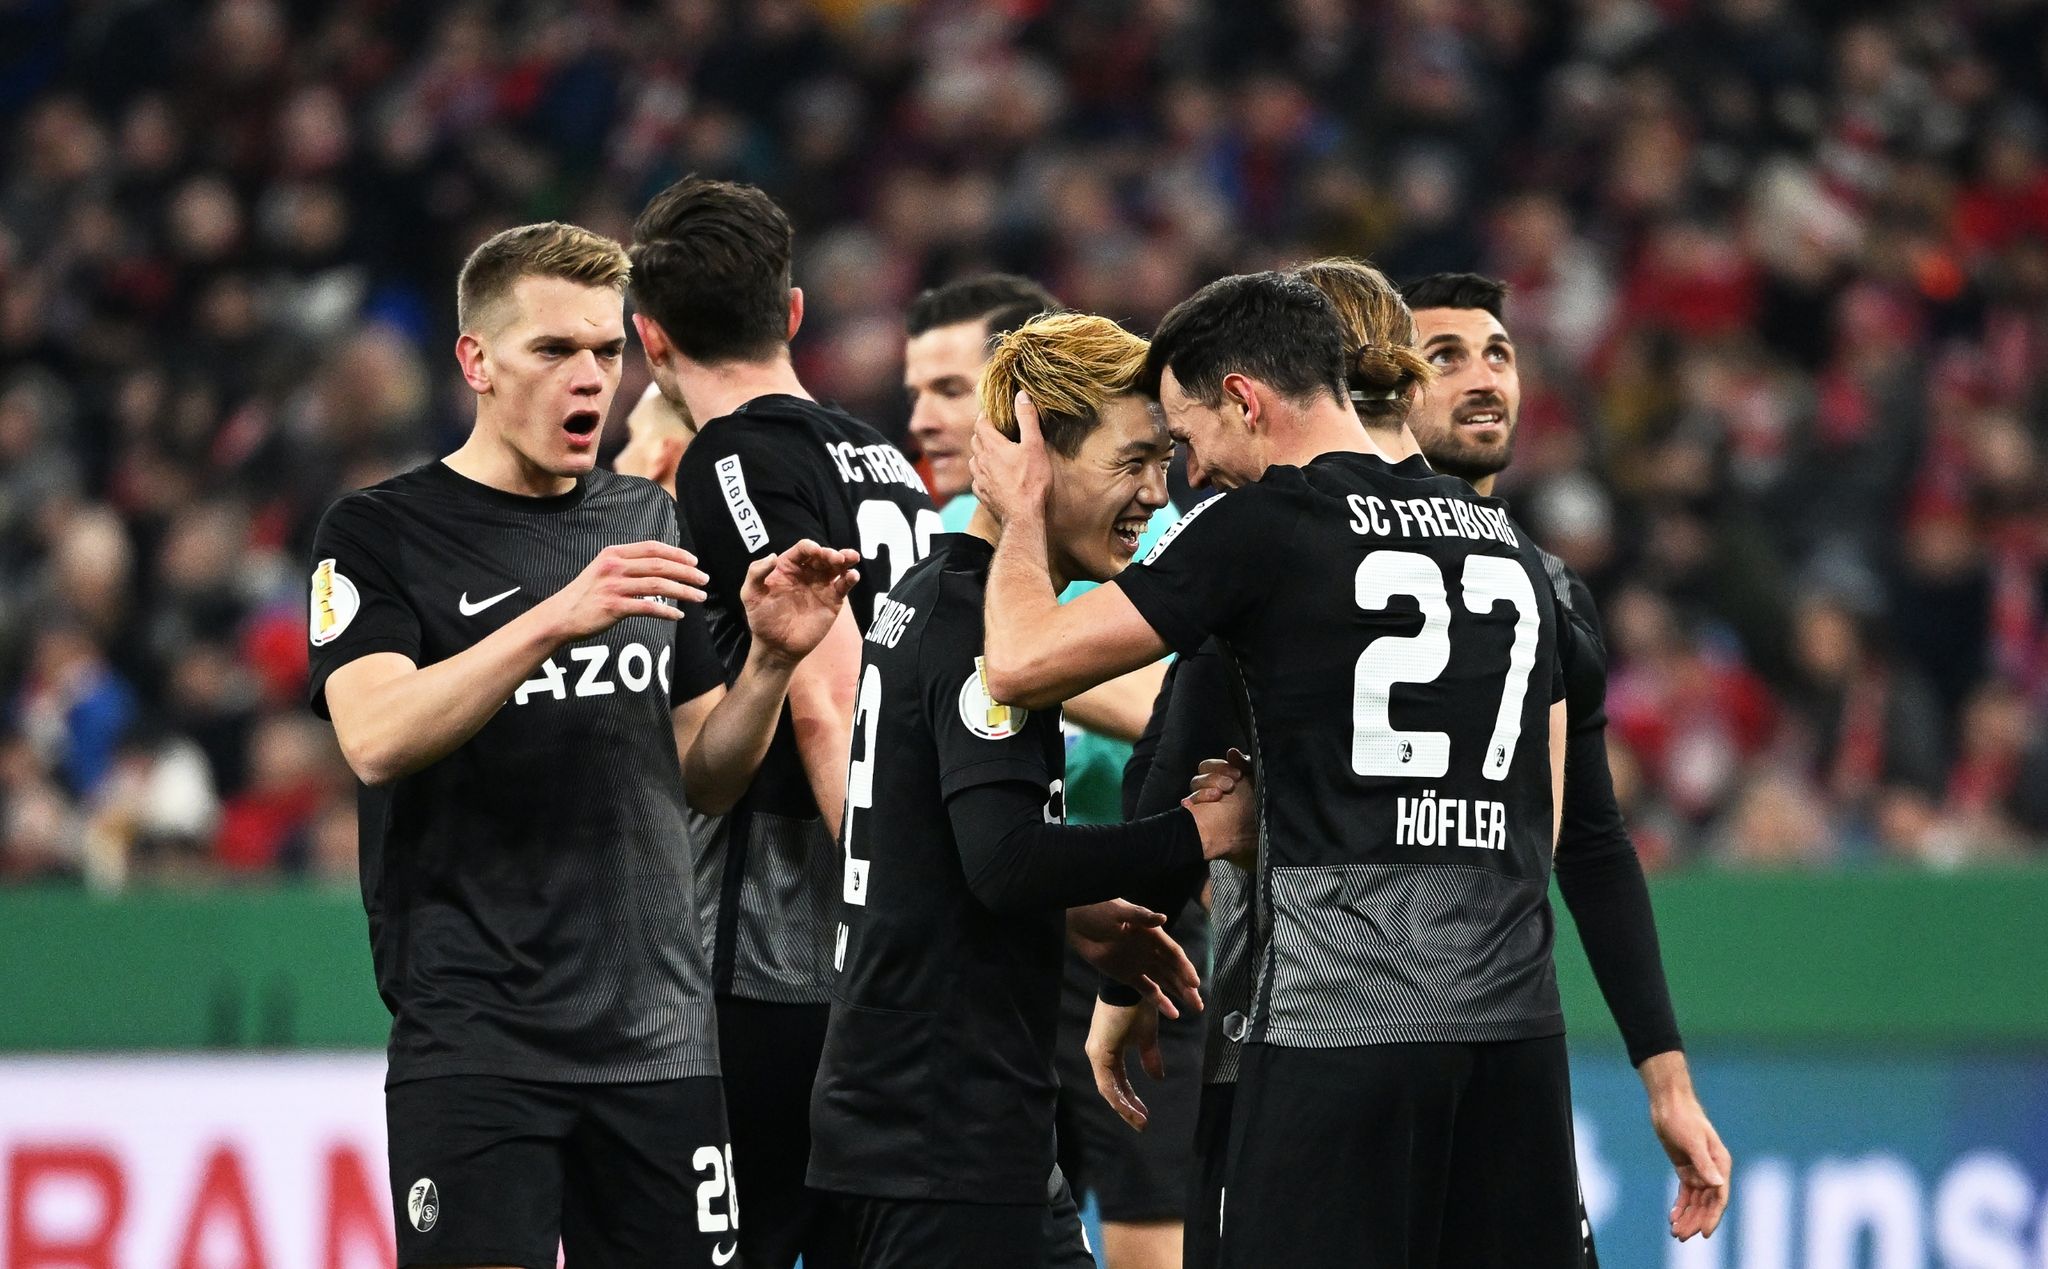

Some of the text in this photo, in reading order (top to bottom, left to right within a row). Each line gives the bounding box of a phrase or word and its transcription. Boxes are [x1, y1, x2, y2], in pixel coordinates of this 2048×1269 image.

[721, 460, 762, 546] BABISTA
[1346, 494, 1520, 549] SC FREIBURG
[504, 642, 671, 706] AZO
[1351, 550, 1541, 781] 27
[841, 660, 882, 907] 2
[1396, 789, 1506, 851] HÖFLER
